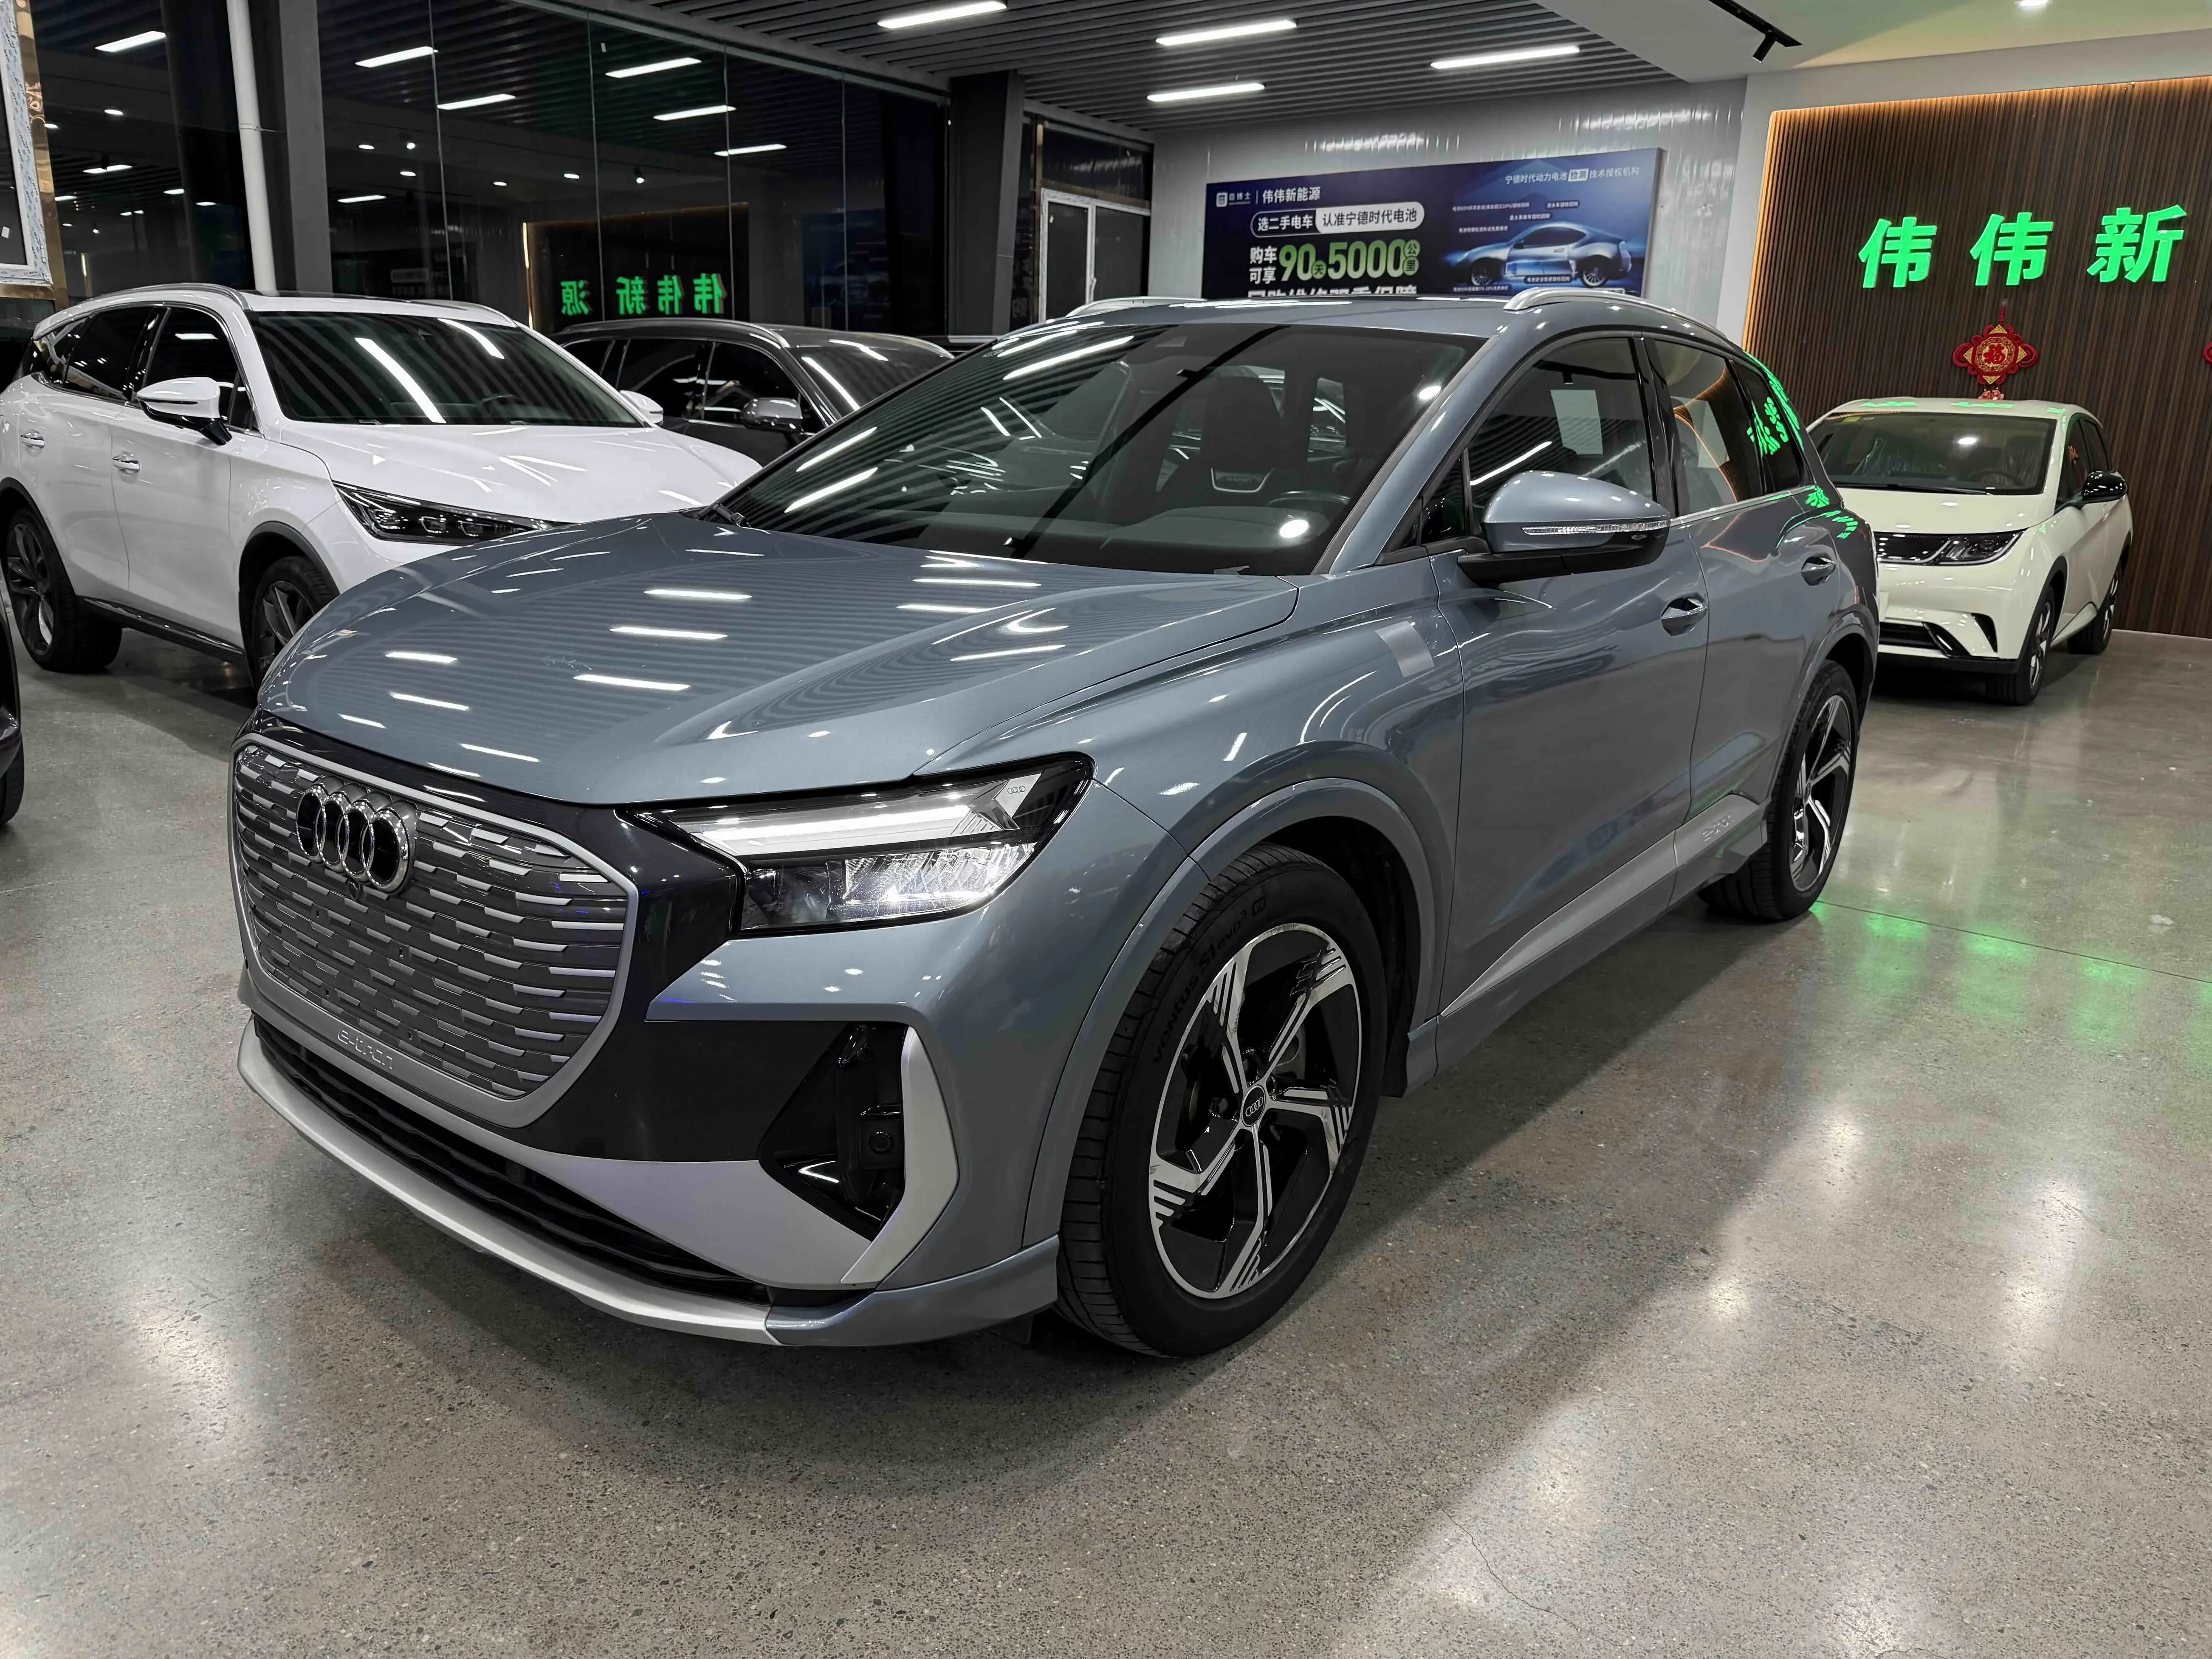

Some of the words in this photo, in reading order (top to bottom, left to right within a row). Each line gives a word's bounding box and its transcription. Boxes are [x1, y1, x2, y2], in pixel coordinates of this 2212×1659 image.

[1262, 186, 1321, 204] 伟伟新能源
[1257, 214, 1313, 231] 选二手电车
[1322, 208, 1417, 227] 认准宁德时代电池
[1250, 246, 1277, 264] 购车
[1249, 266, 1276, 284] 可享
[1983, 343, 2006, 364] 福
